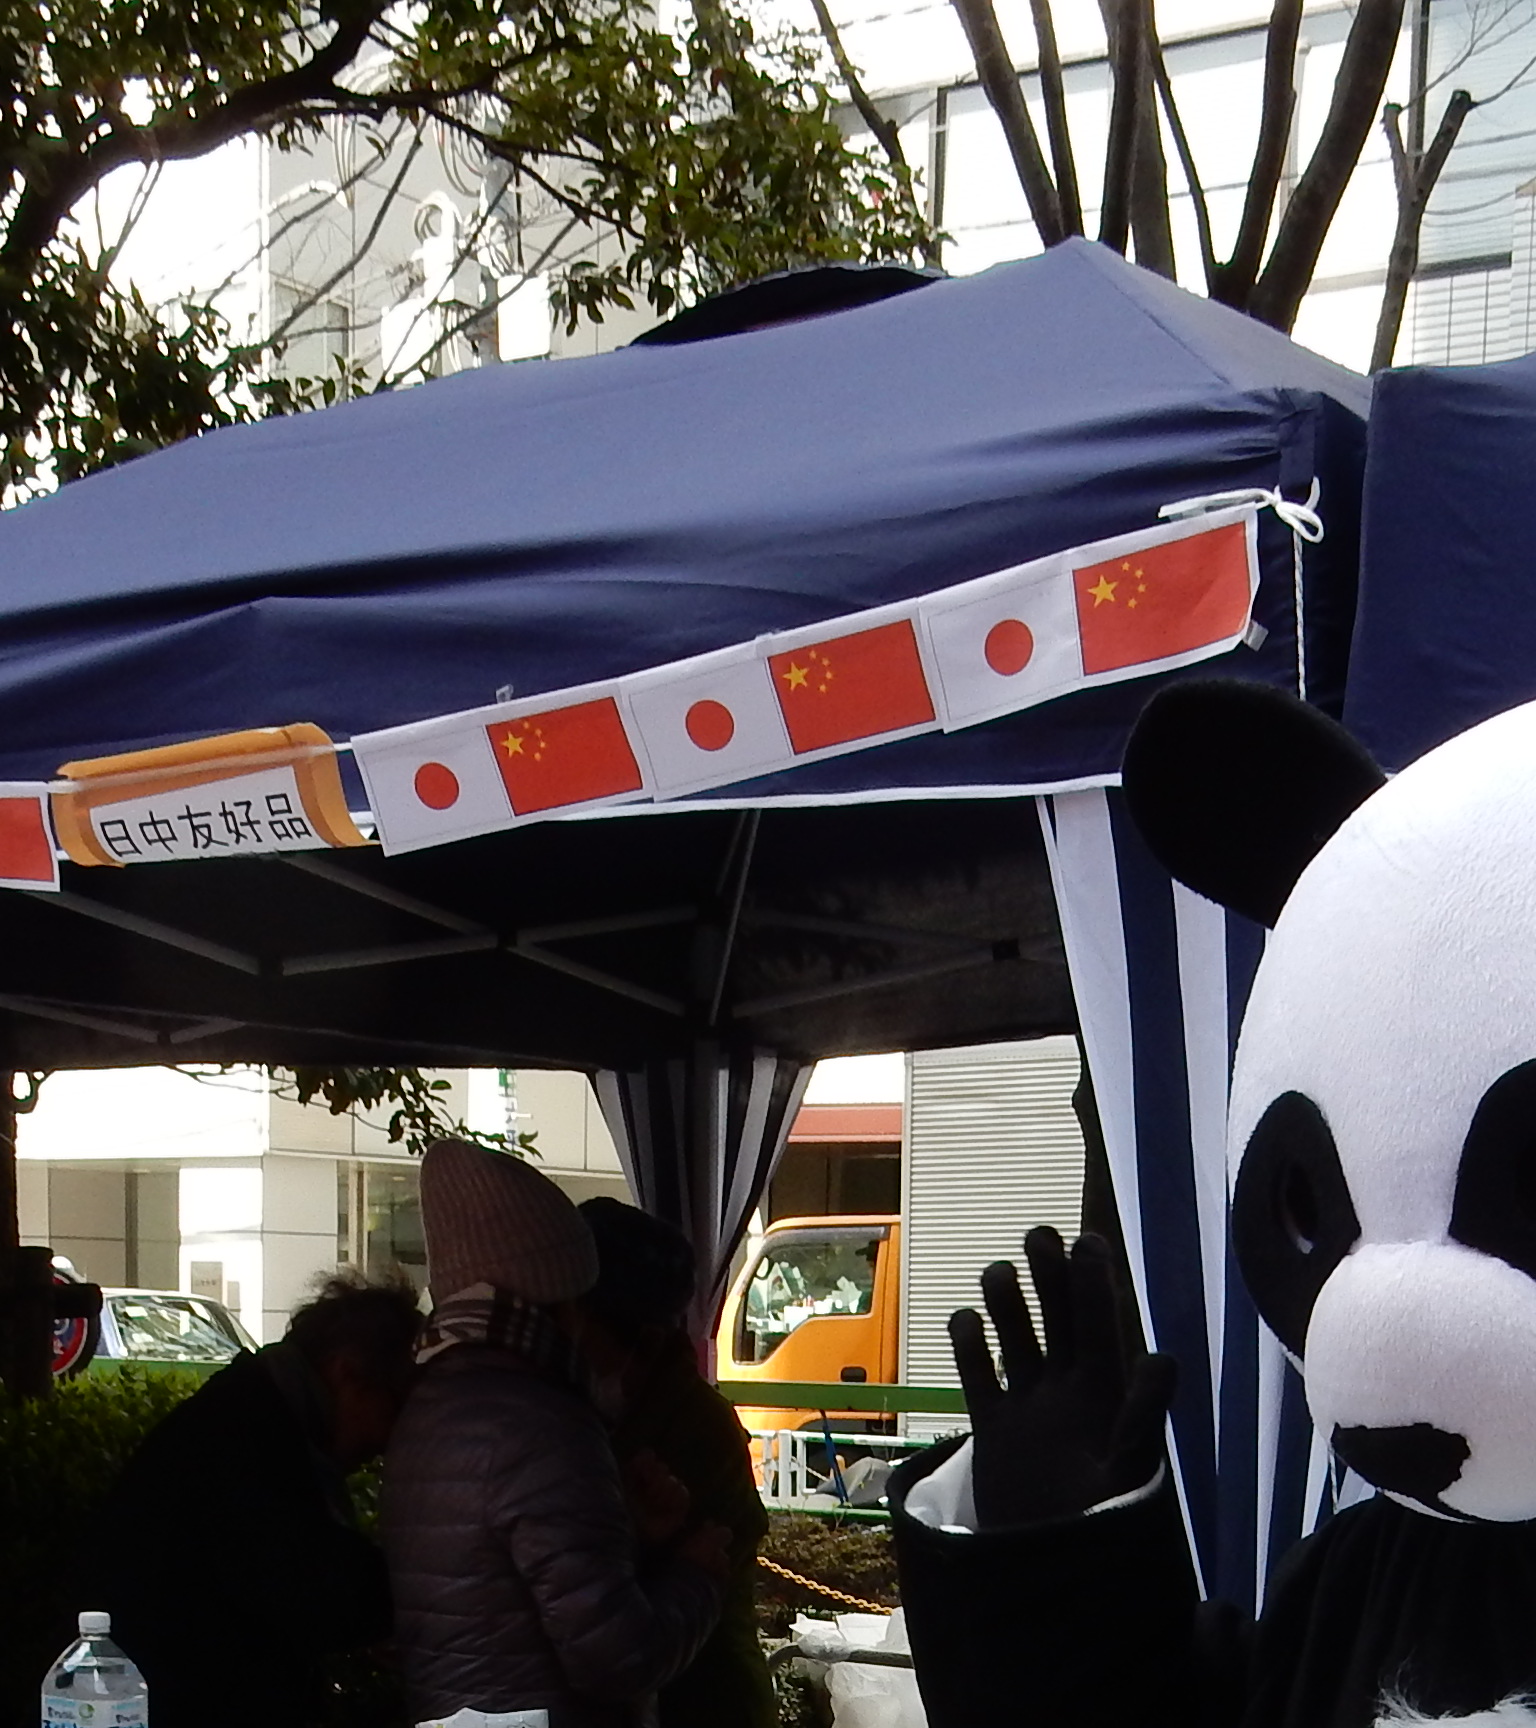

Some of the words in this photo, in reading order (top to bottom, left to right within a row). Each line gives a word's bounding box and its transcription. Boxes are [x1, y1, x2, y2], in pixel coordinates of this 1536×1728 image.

[100, 792, 314, 857] 日中友好品
